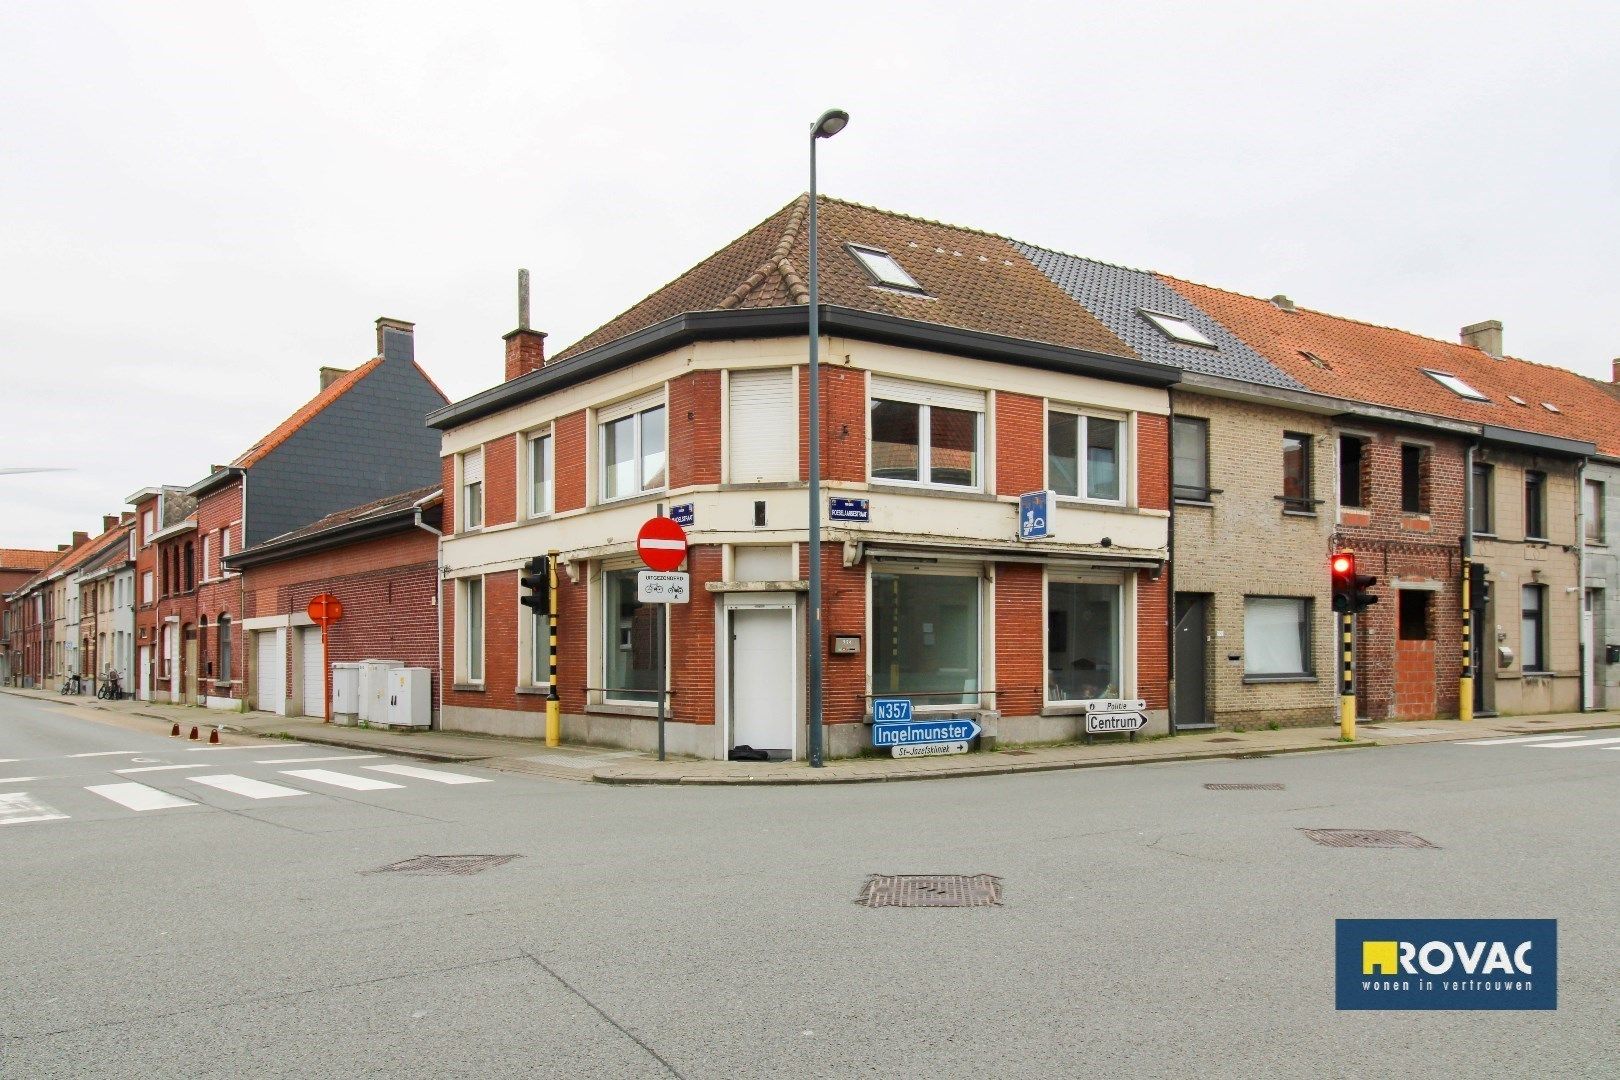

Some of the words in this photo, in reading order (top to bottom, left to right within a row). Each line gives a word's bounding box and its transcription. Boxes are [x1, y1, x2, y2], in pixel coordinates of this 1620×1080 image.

[878, 703, 908, 719] N357
[1090, 715, 1138, 730] Centrum
[878, 721, 968, 745] Ingelmunster
